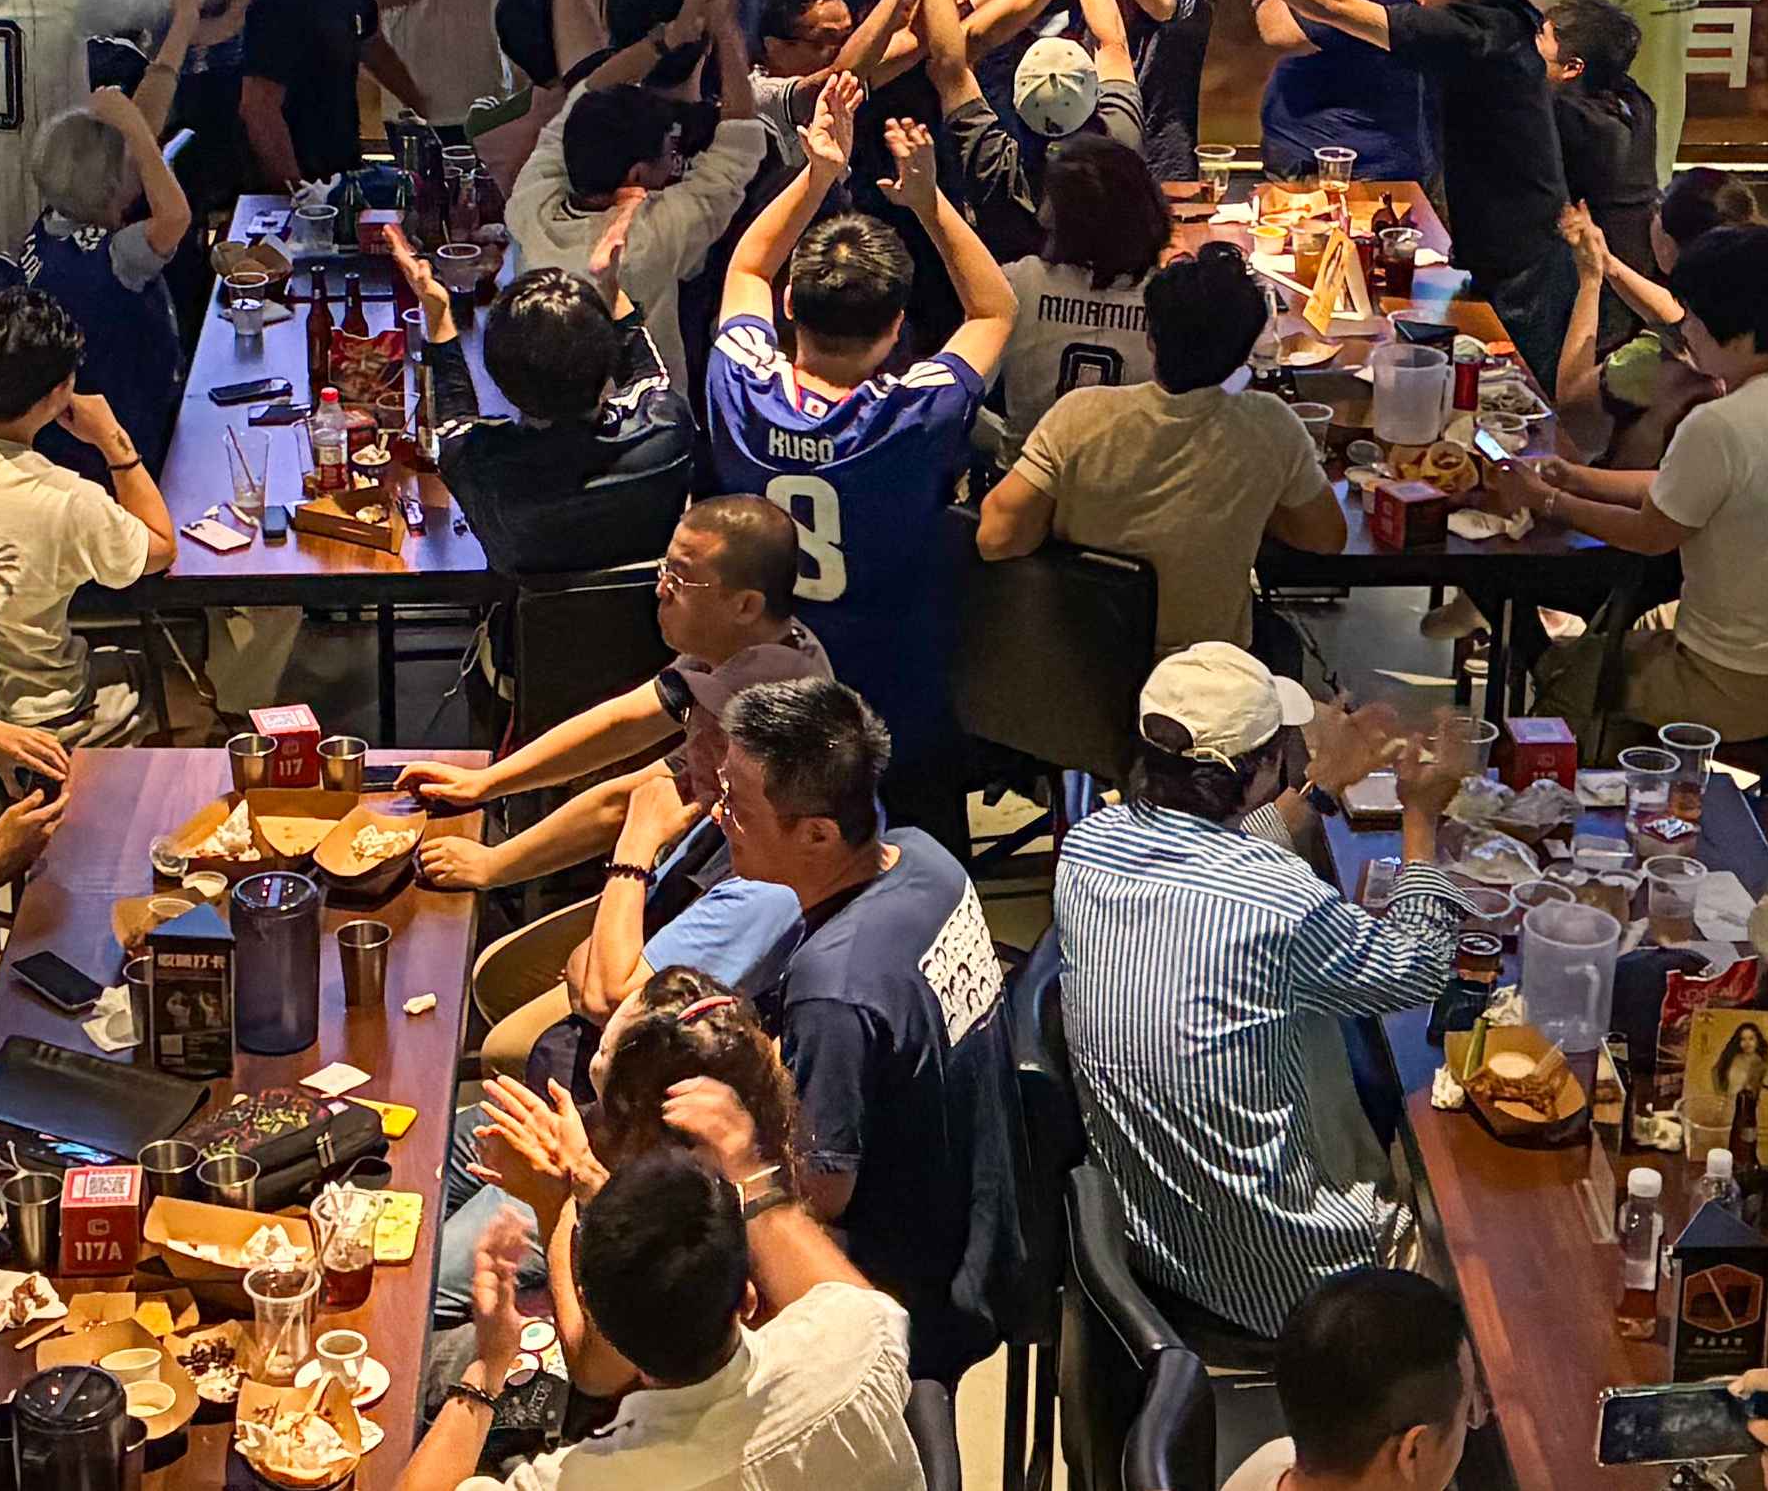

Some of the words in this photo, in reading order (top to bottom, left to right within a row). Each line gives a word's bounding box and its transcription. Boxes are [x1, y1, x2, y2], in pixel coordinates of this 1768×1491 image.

[1038, 295, 1147, 331] MINAMIN
[768, 427, 836, 464] KUBO
[278, 758, 303, 777] 117
[74, 1241, 123, 1261] 117A
